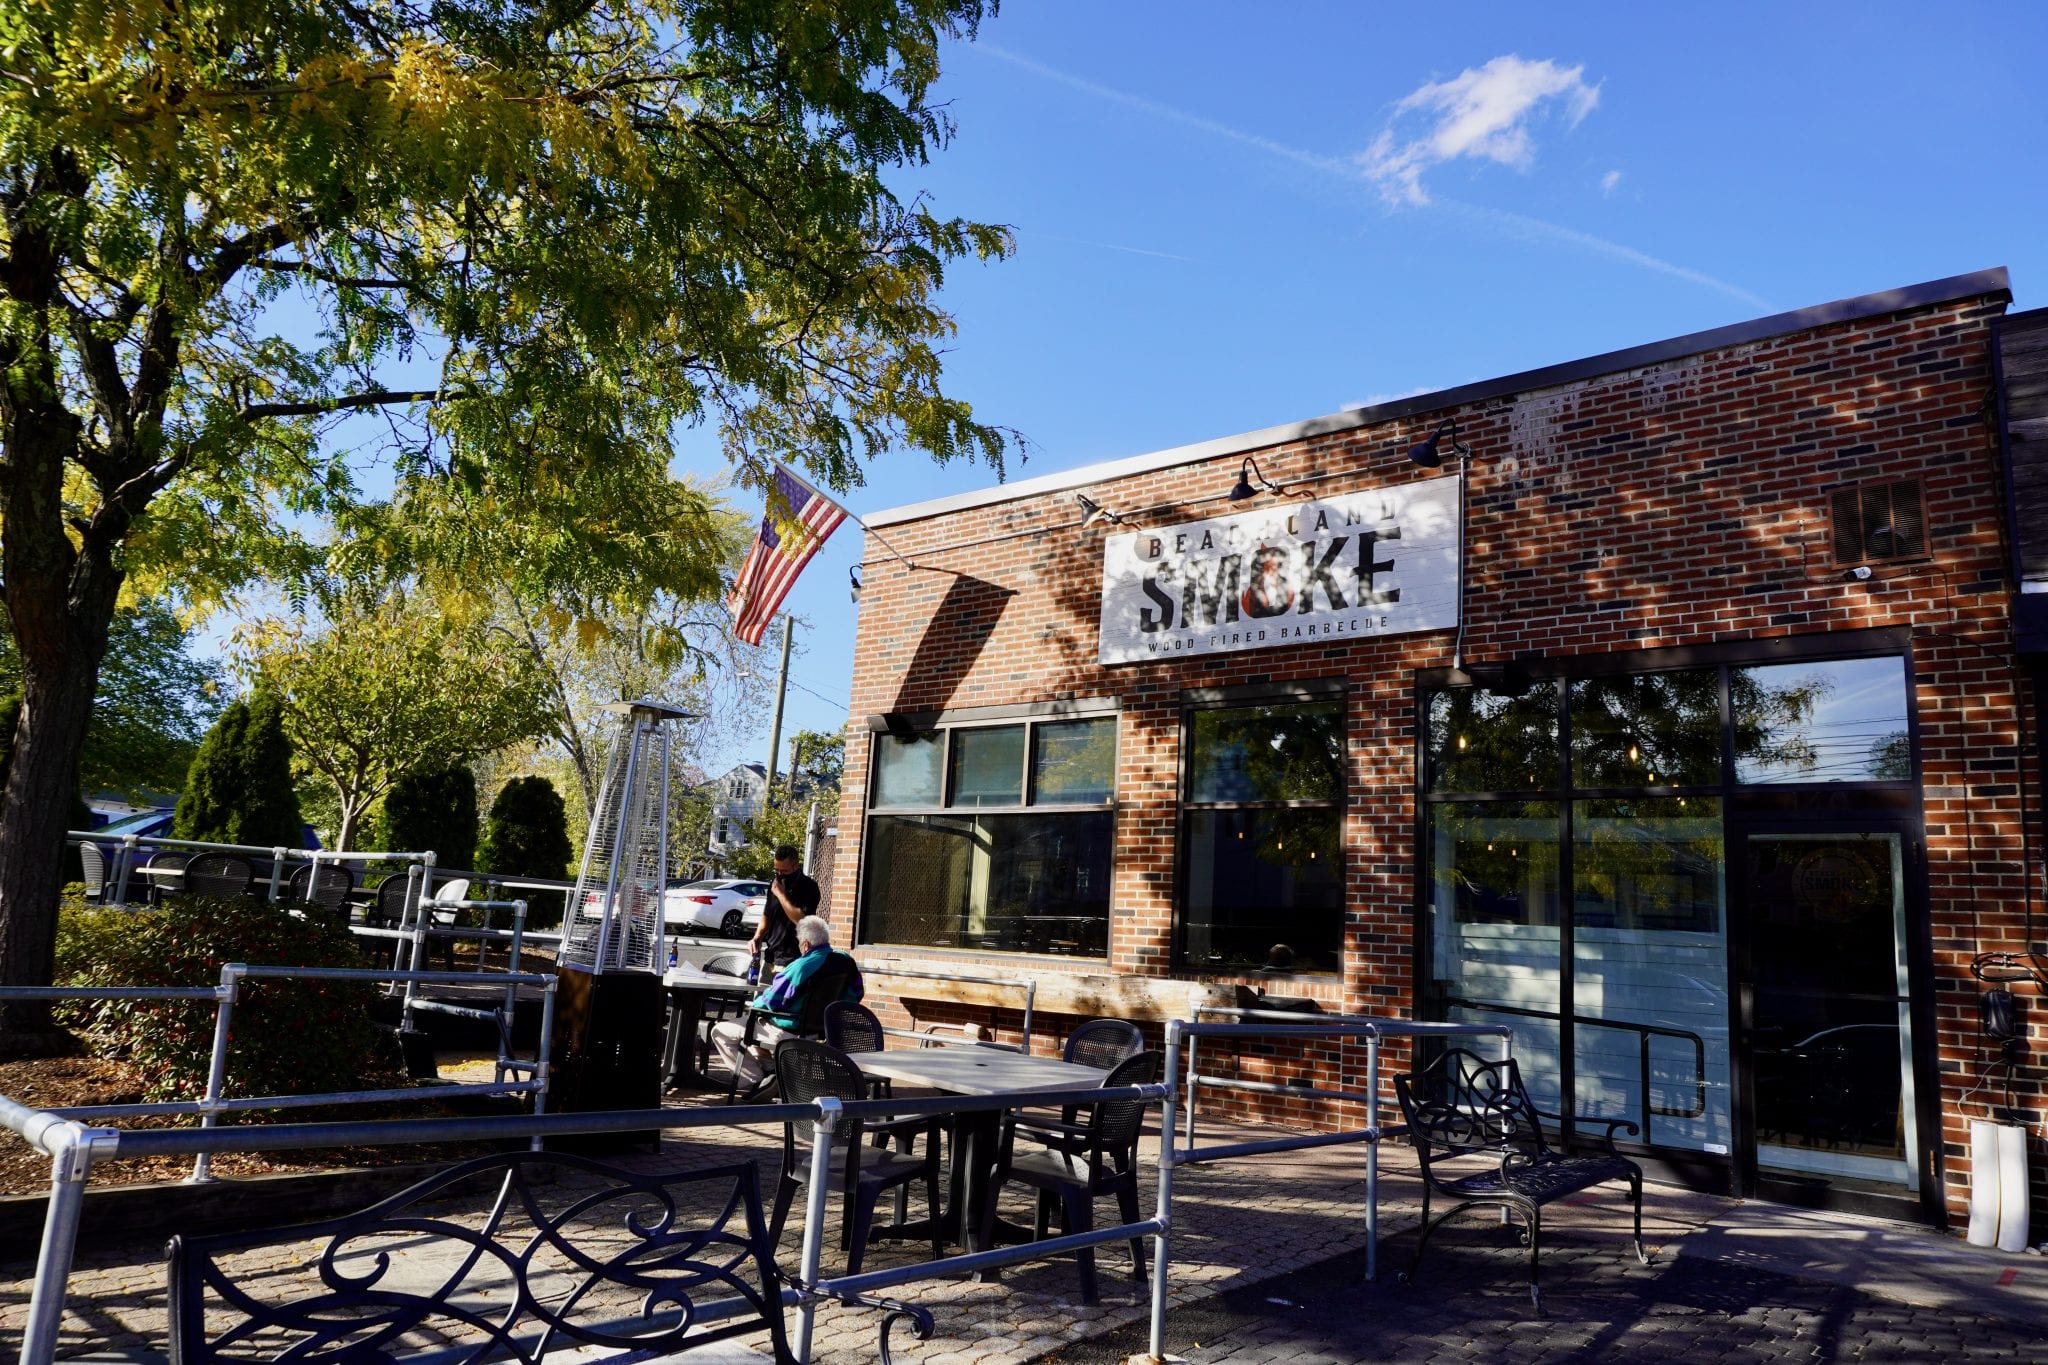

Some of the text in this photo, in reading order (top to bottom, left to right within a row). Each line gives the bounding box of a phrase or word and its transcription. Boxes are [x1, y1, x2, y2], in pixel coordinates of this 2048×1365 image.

[1139, 526, 1401, 633] SMOKE
[1148, 616, 1388, 652] WOOD FIRED BARBECUE
